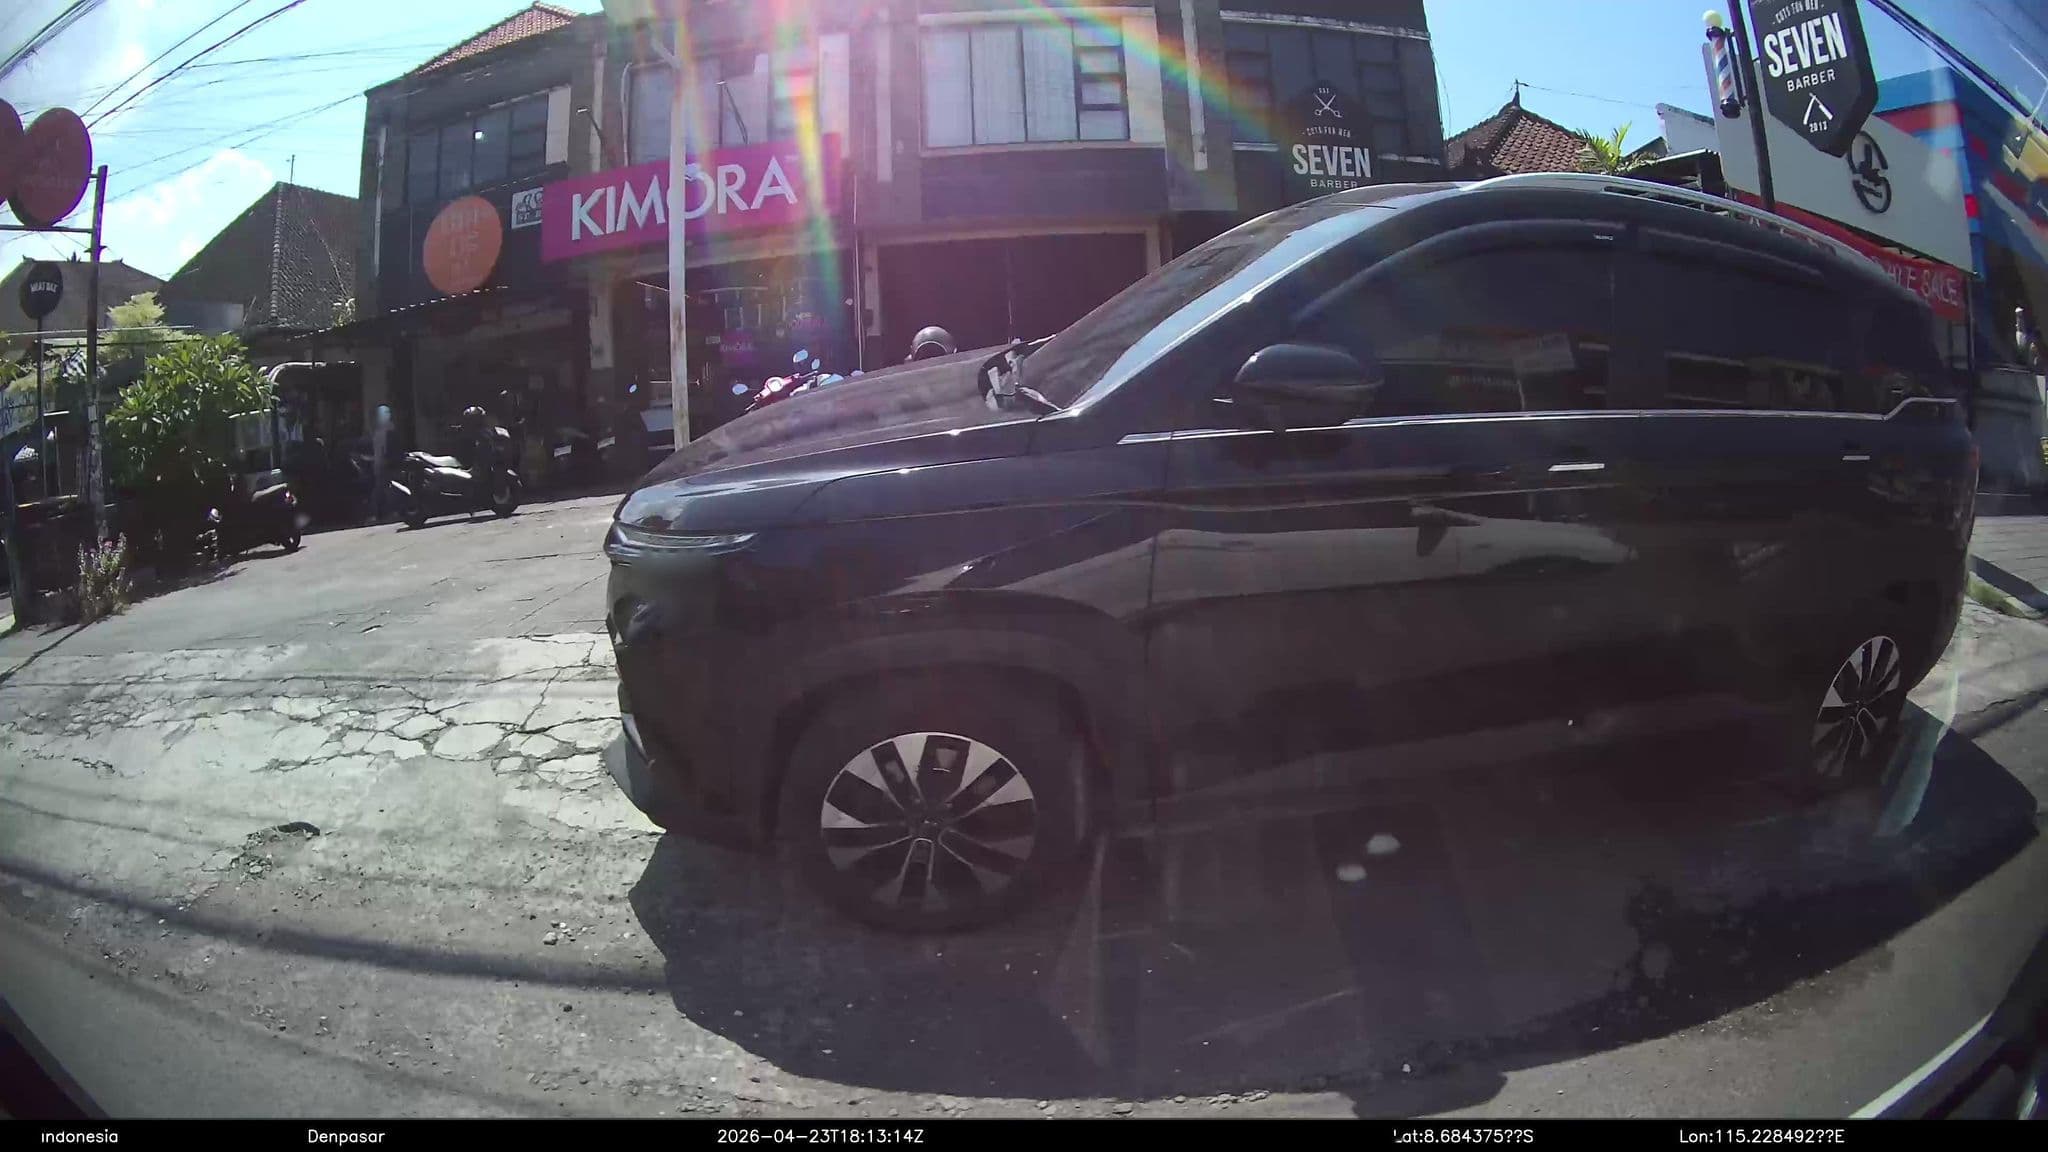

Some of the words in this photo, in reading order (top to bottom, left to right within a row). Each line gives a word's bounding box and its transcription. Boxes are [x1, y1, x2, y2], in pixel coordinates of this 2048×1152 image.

[1763, 11, 1848, 78] SEVEN
[1786, 68, 1836, 92] BARBER
[1292, 143, 1371, 178] SEVEN
[571, 155, 799, 241] KIMORA
[1310, 179, 1358, 189] BARBER
